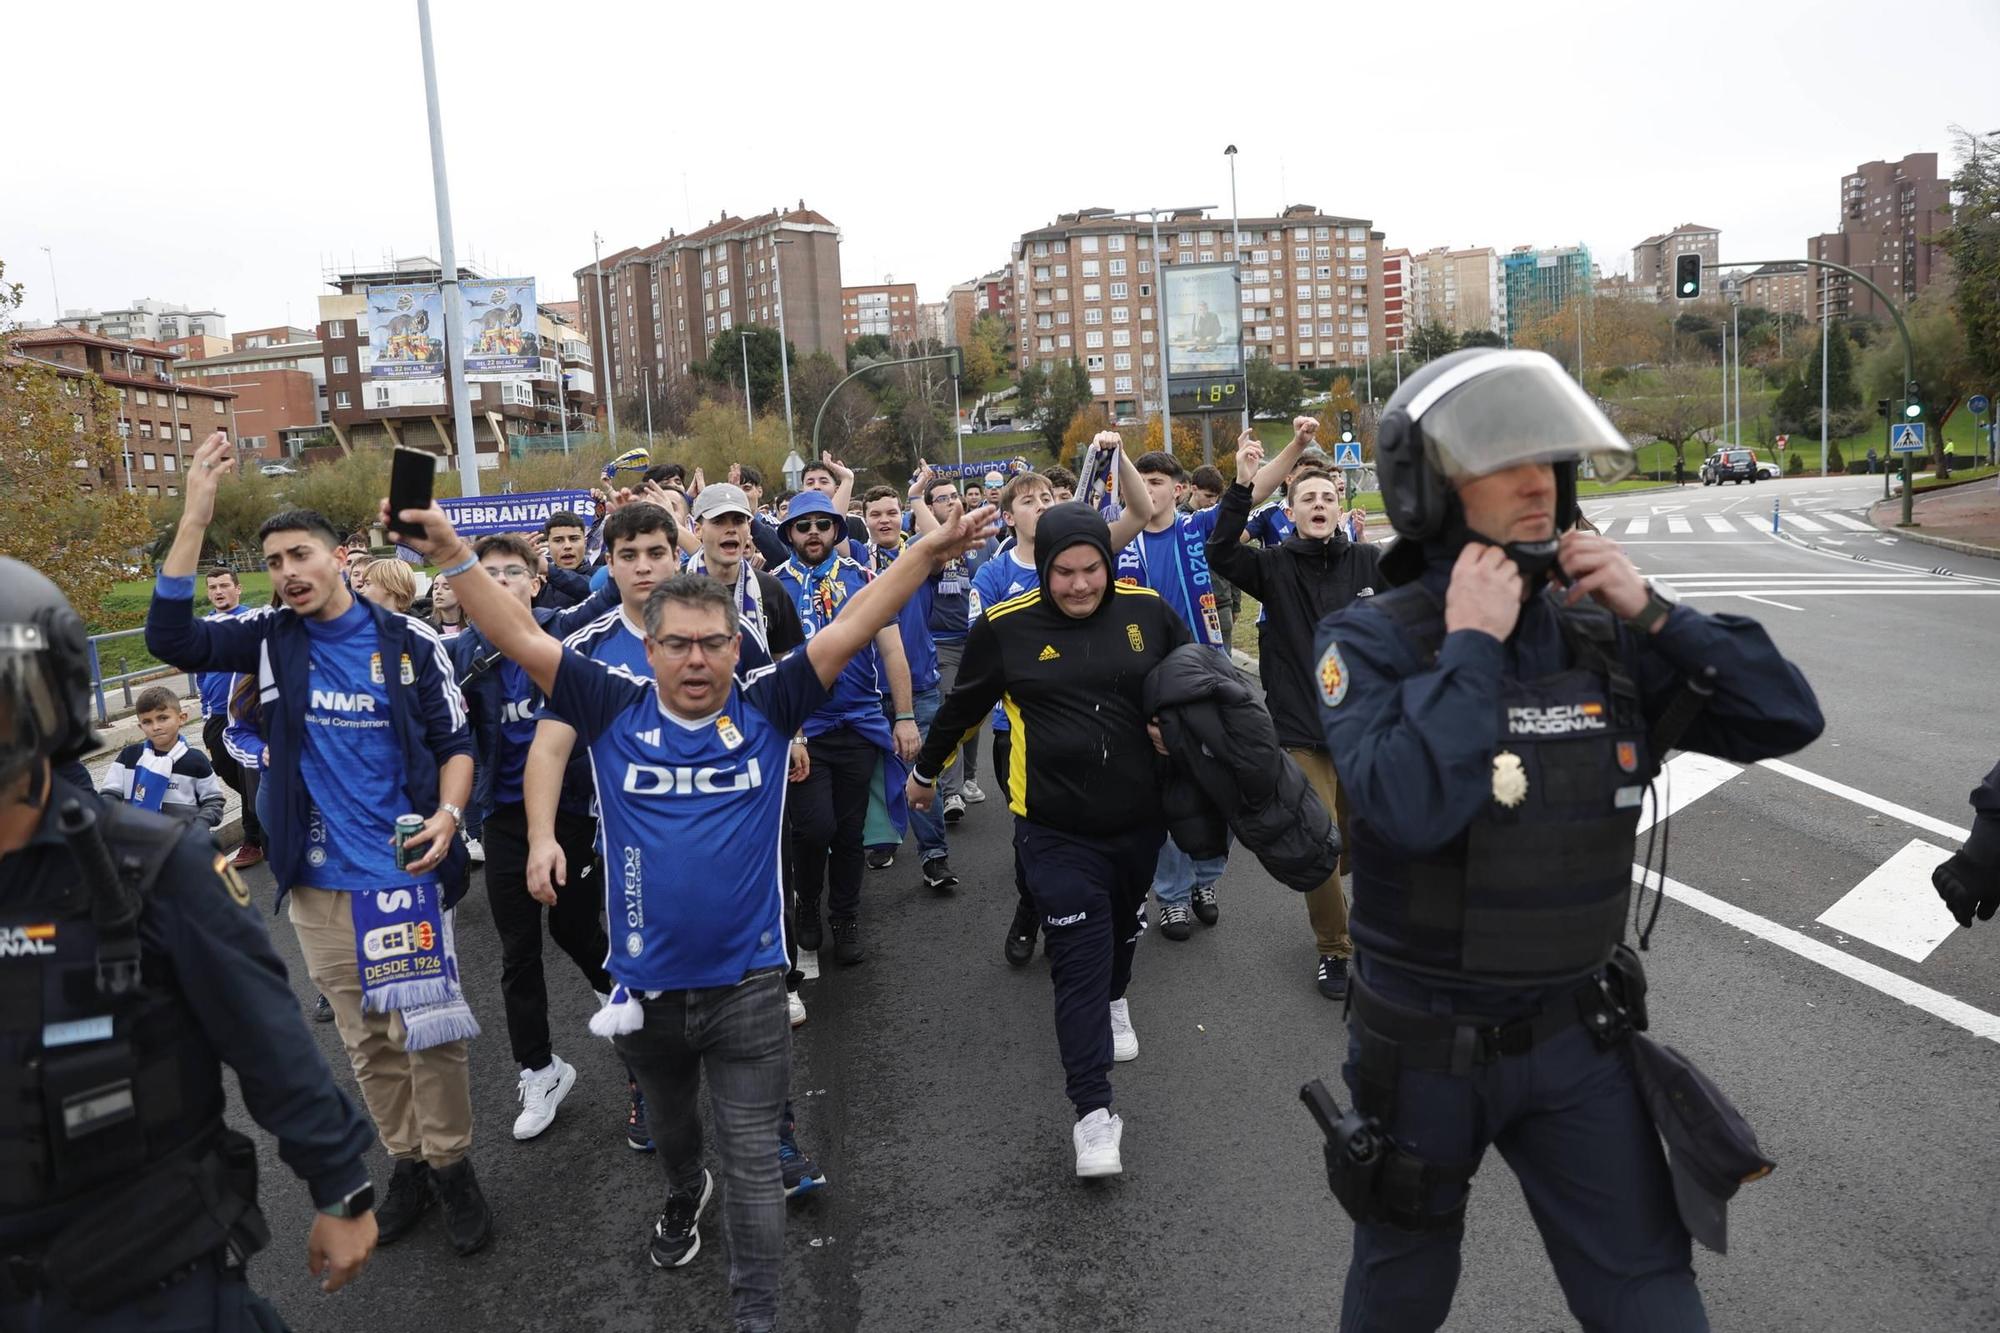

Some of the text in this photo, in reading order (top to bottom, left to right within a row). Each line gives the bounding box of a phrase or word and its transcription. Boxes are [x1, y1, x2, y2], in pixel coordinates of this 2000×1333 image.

[964, 460, 1007, 476] OVIEDO
[1184, 530, 1211, 586] 1926
[311, 689, 376, 713] NMR
[1509, 717, 1607, 734] NACIONAL
[623, 757, 762, 795] DIGI
[624, 846, 638, 928] OVIEDO
[365, 956, 441, 980] DESDE 1926
